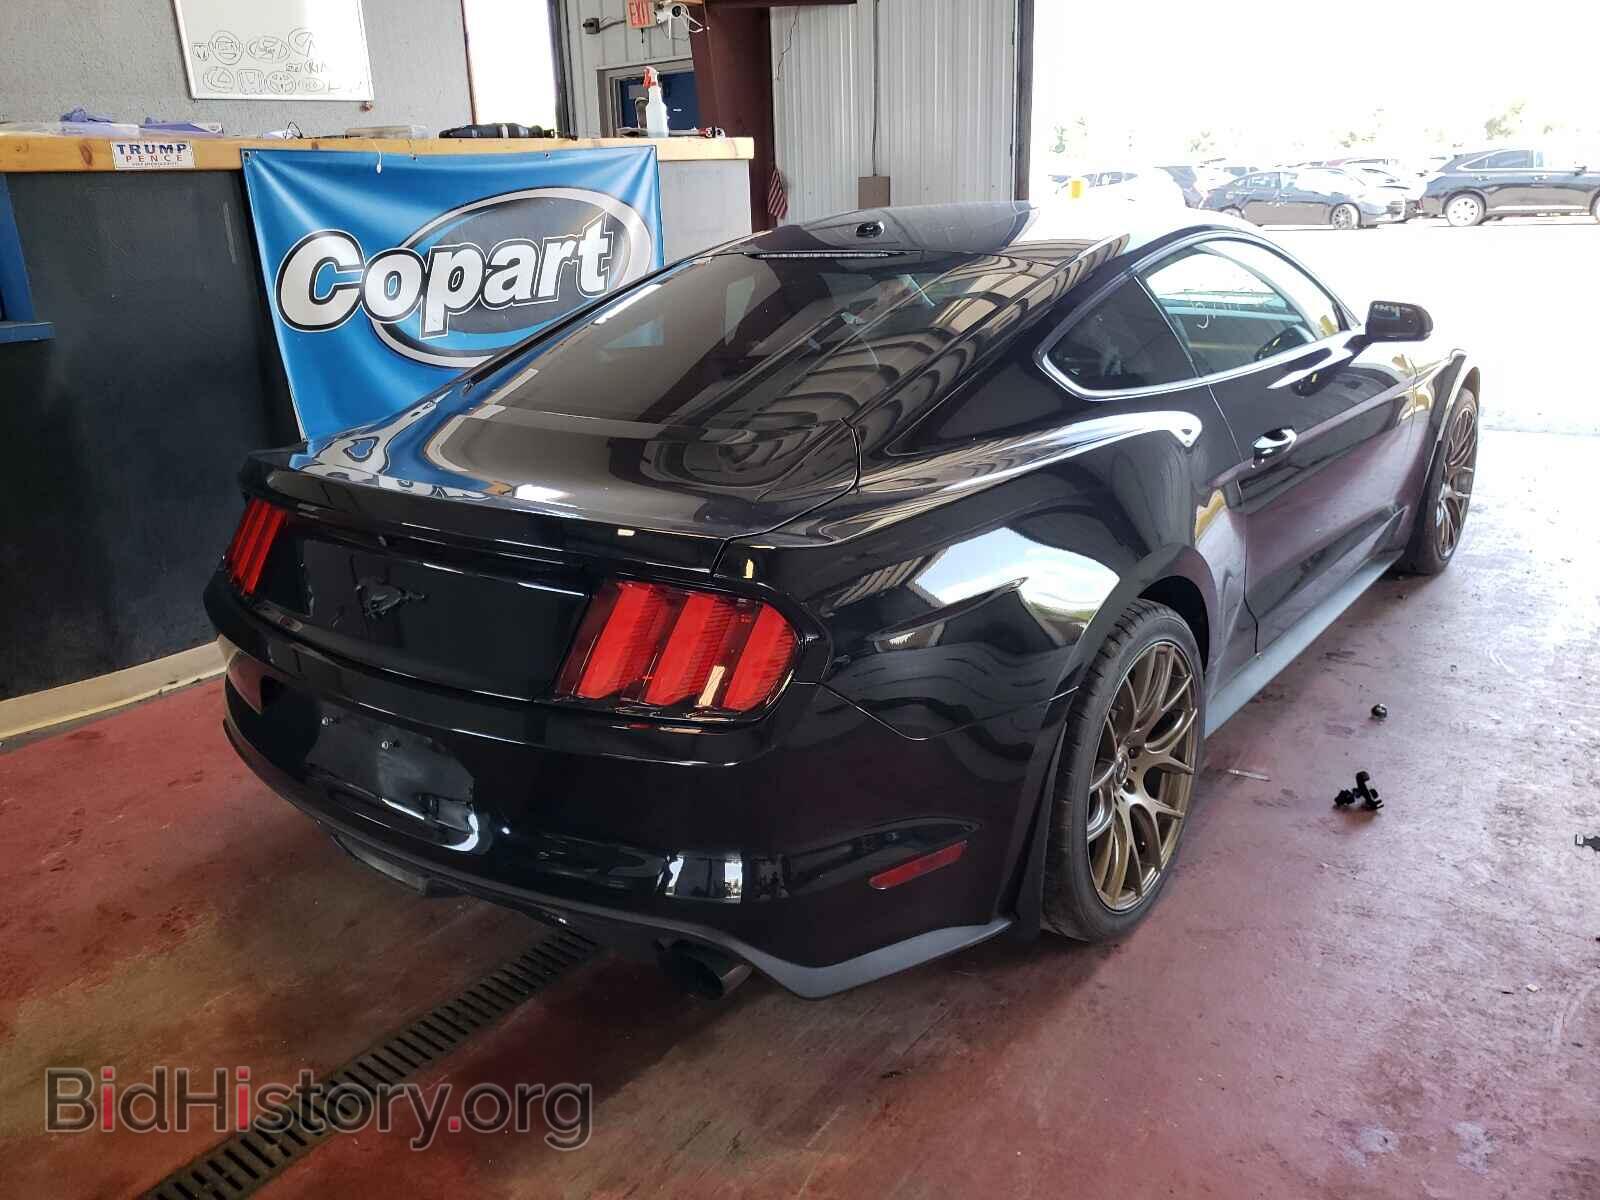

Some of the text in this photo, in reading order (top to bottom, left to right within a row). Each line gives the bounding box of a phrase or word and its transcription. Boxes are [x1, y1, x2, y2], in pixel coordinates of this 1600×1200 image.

[628, 2, 651, 25] EXIT
[116, 144, 187, 155] TRUMP
[126, 154, 183, 163] PENCE
[274, 208, 614, 340] Copart
